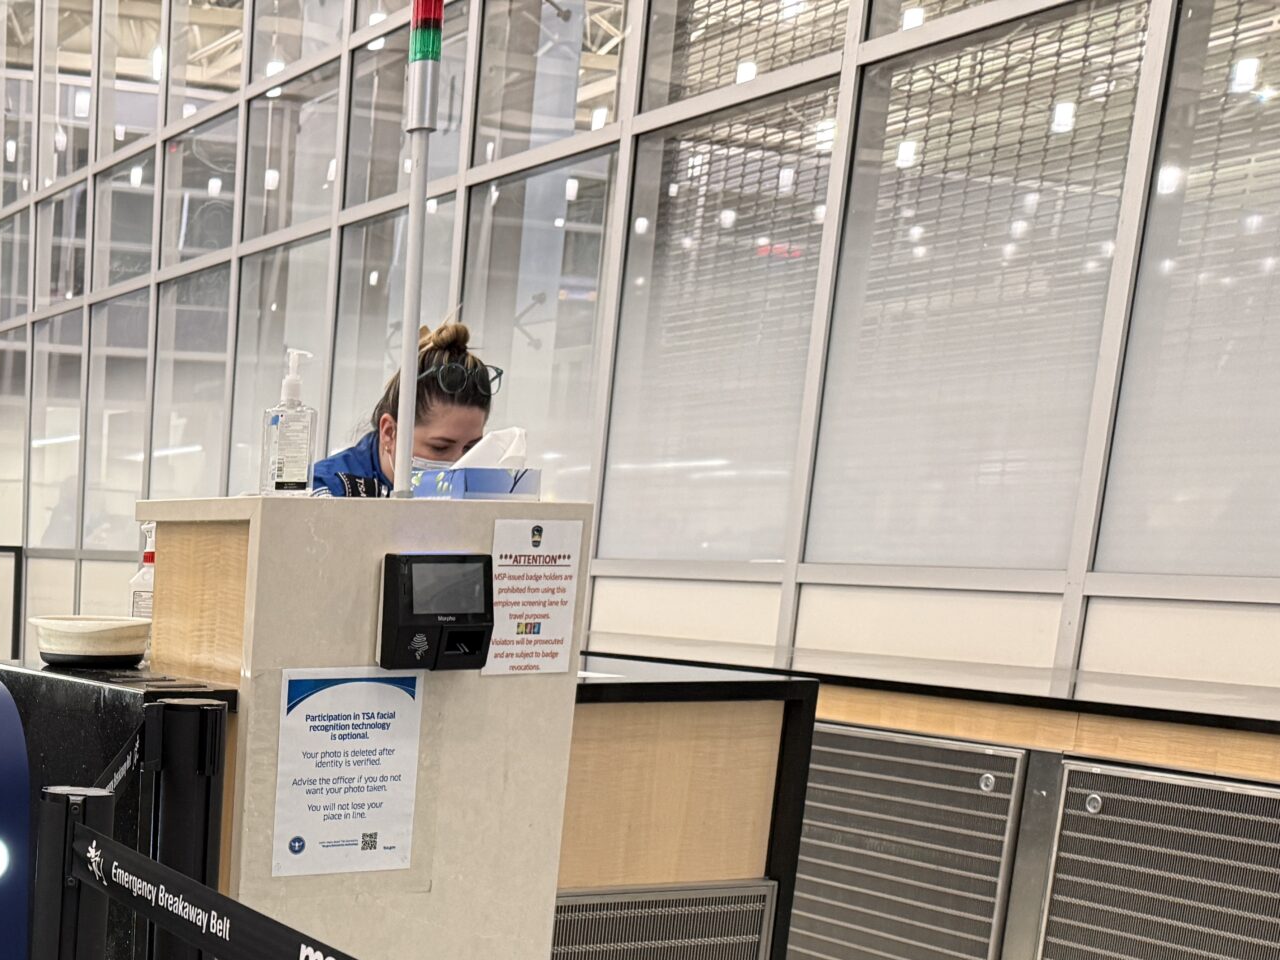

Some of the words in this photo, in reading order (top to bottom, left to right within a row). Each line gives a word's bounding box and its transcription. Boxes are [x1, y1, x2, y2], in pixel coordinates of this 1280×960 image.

[525, 573, 542, 582] badge
[543, 573, 563, 581] holders
[498, 586, 527, 595] prohibited
[541, 587, 556, 595] using
[493, 600, 520, 608] employee
[521, 599, 547, 607] screening
[560, 598, 569, 606] for
[509, 612, 524, 620] travel
[524, 613, 550, 621] purposes.
[533, 637, 564, 646] prosecuted
[494, 651, 505, 659] and
[515, 651, 534, 659] subject
[542, 650, 559, 659] badge
[305, 712, 352, 723] Participation
[353, 712, 360, 721] in
[362, 712, 375, 720] TSA
[376, 711, 396, 720] facial
[309, 723, 350, 732] recognition
[351, 721, 391, 730] technology
[338, 732, 369, 741] optional.
[302, 751, 319, 759] Your
[320, 749, 342, 759] photo
[343, 750, 349, 758] is
[350, 748, 377, 757] deleted
[378, 747, 396, 756] after
[315, 760, 343, 769] identity
[344, 759, 351, 767] is
[352, 758, 381, 766] verified.
[292, 777, 318, 786] Advise
[318, 777, 331, 785] the
[332, 776, 355, 785] officer
[357, 775, 363, 783] if
[364, 776, 378, 785] you
[378, 774, 388, 782] do
[305, 787, 323, 795] want
[325, 786, 342, 795] your
[343, 785, 365, 794] photo
[366, 784, 387, 792] taken.
[307, 804, 321, 812] You
[322, 803, 336, 811] will
[337, 803, 350, 811] not
[351, 801, 366, 810] lose
[366, 801, 383, 810] your
[323, 812, 342, 821] place
[343, 812, 351, 820] in
[352, 811, 367, 819] line.
[110, 861, 158, 908] Emergency
[158, 884, 209, 934] Breakaway
[209, 910, 231, 941] Belt
